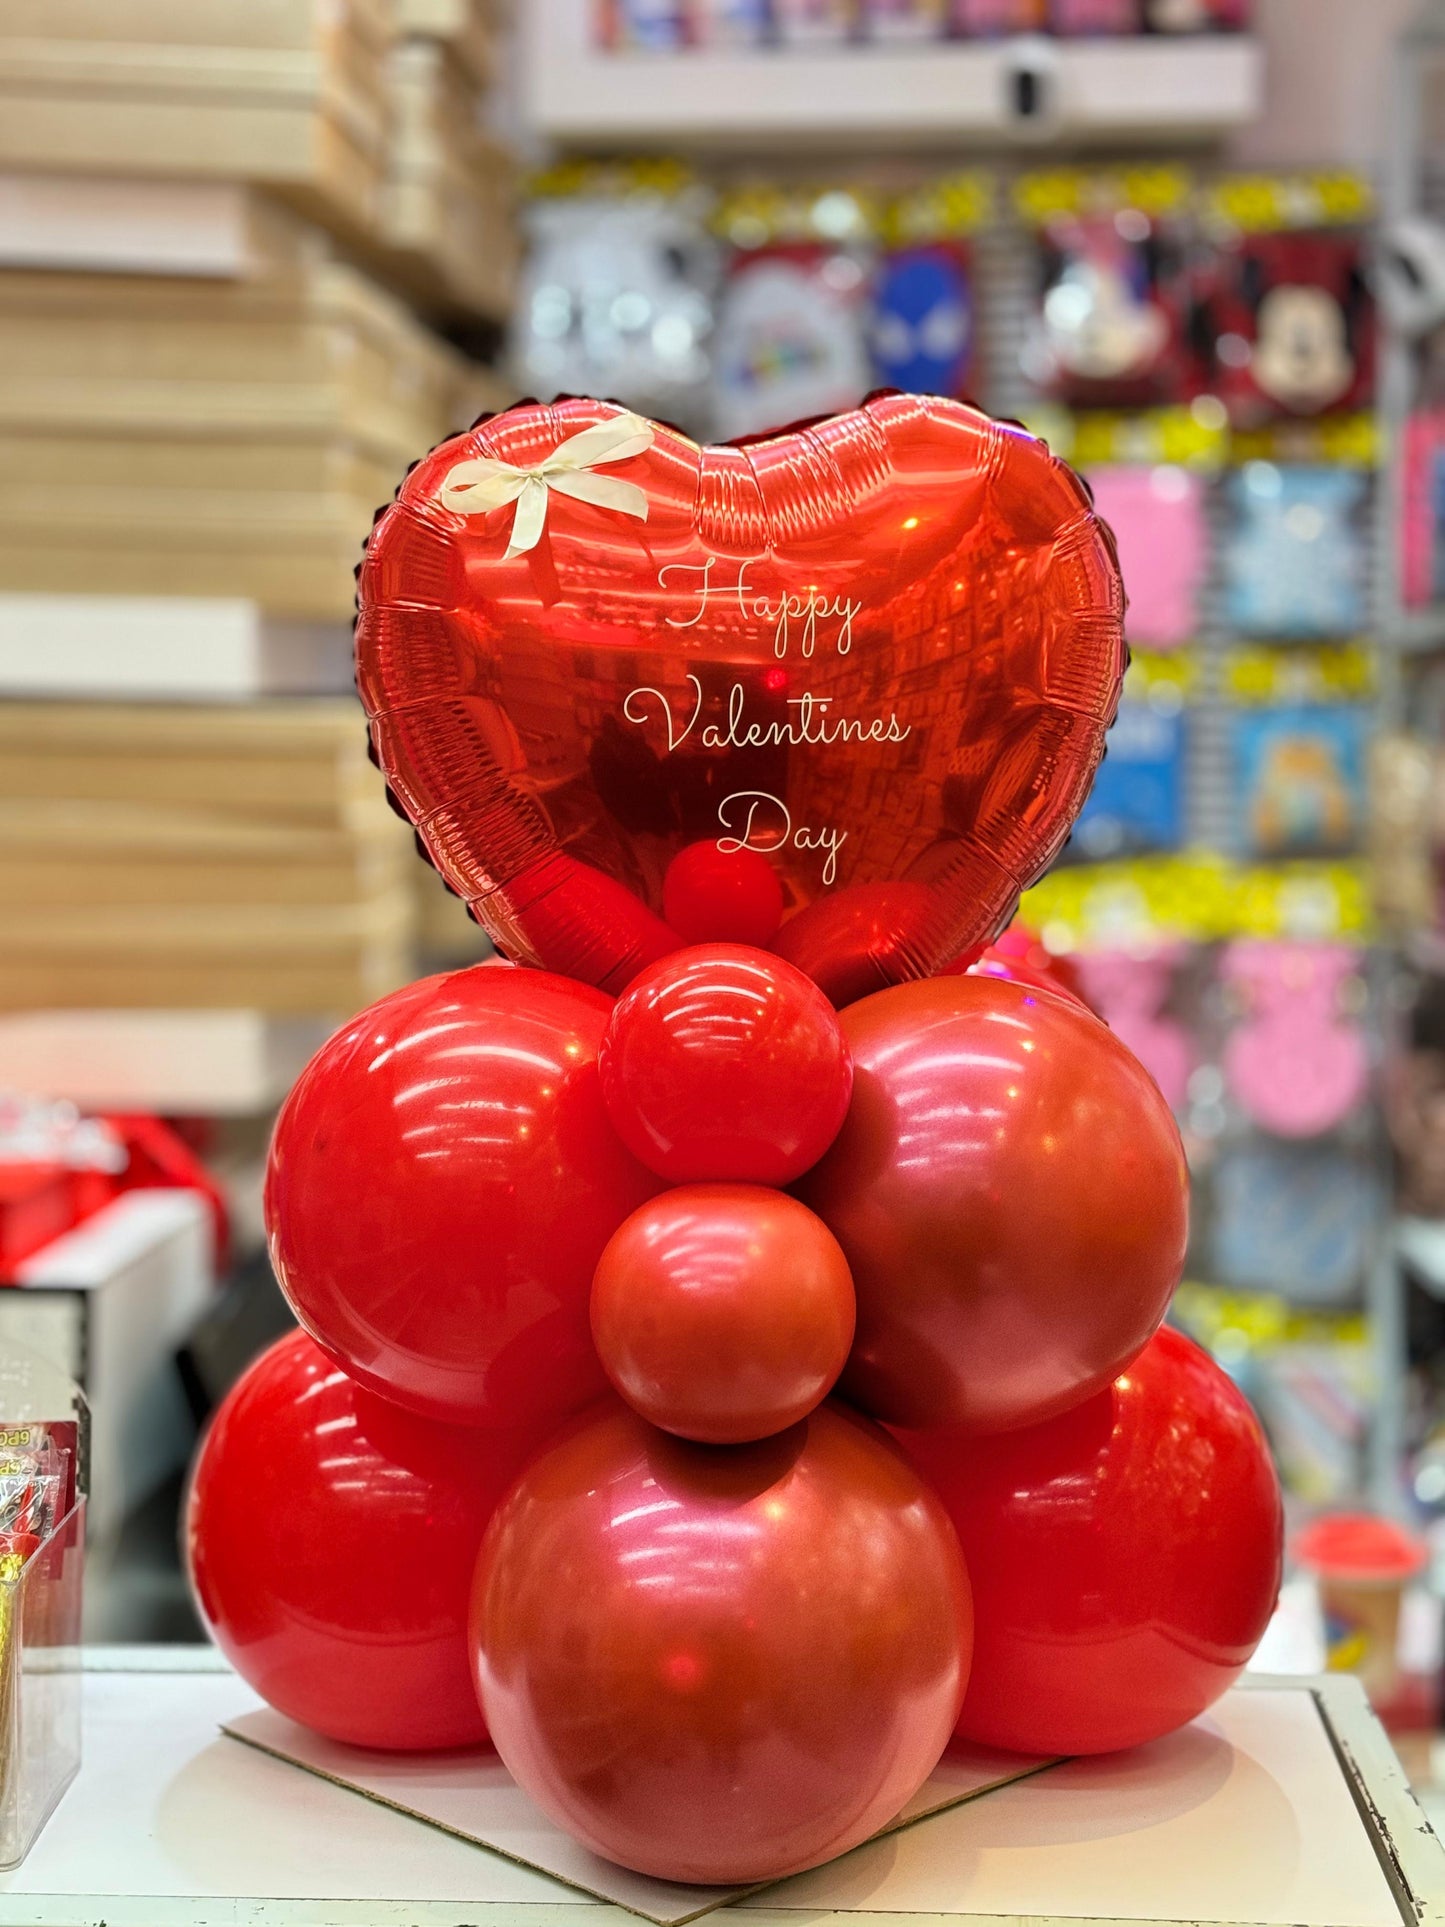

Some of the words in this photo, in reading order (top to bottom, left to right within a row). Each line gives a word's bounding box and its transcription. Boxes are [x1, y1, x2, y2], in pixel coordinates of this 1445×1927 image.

[658, 557, 862, 659] Happy
[623, 674, 911, 752] Valentines
[716, 791, 848, 885] Day
